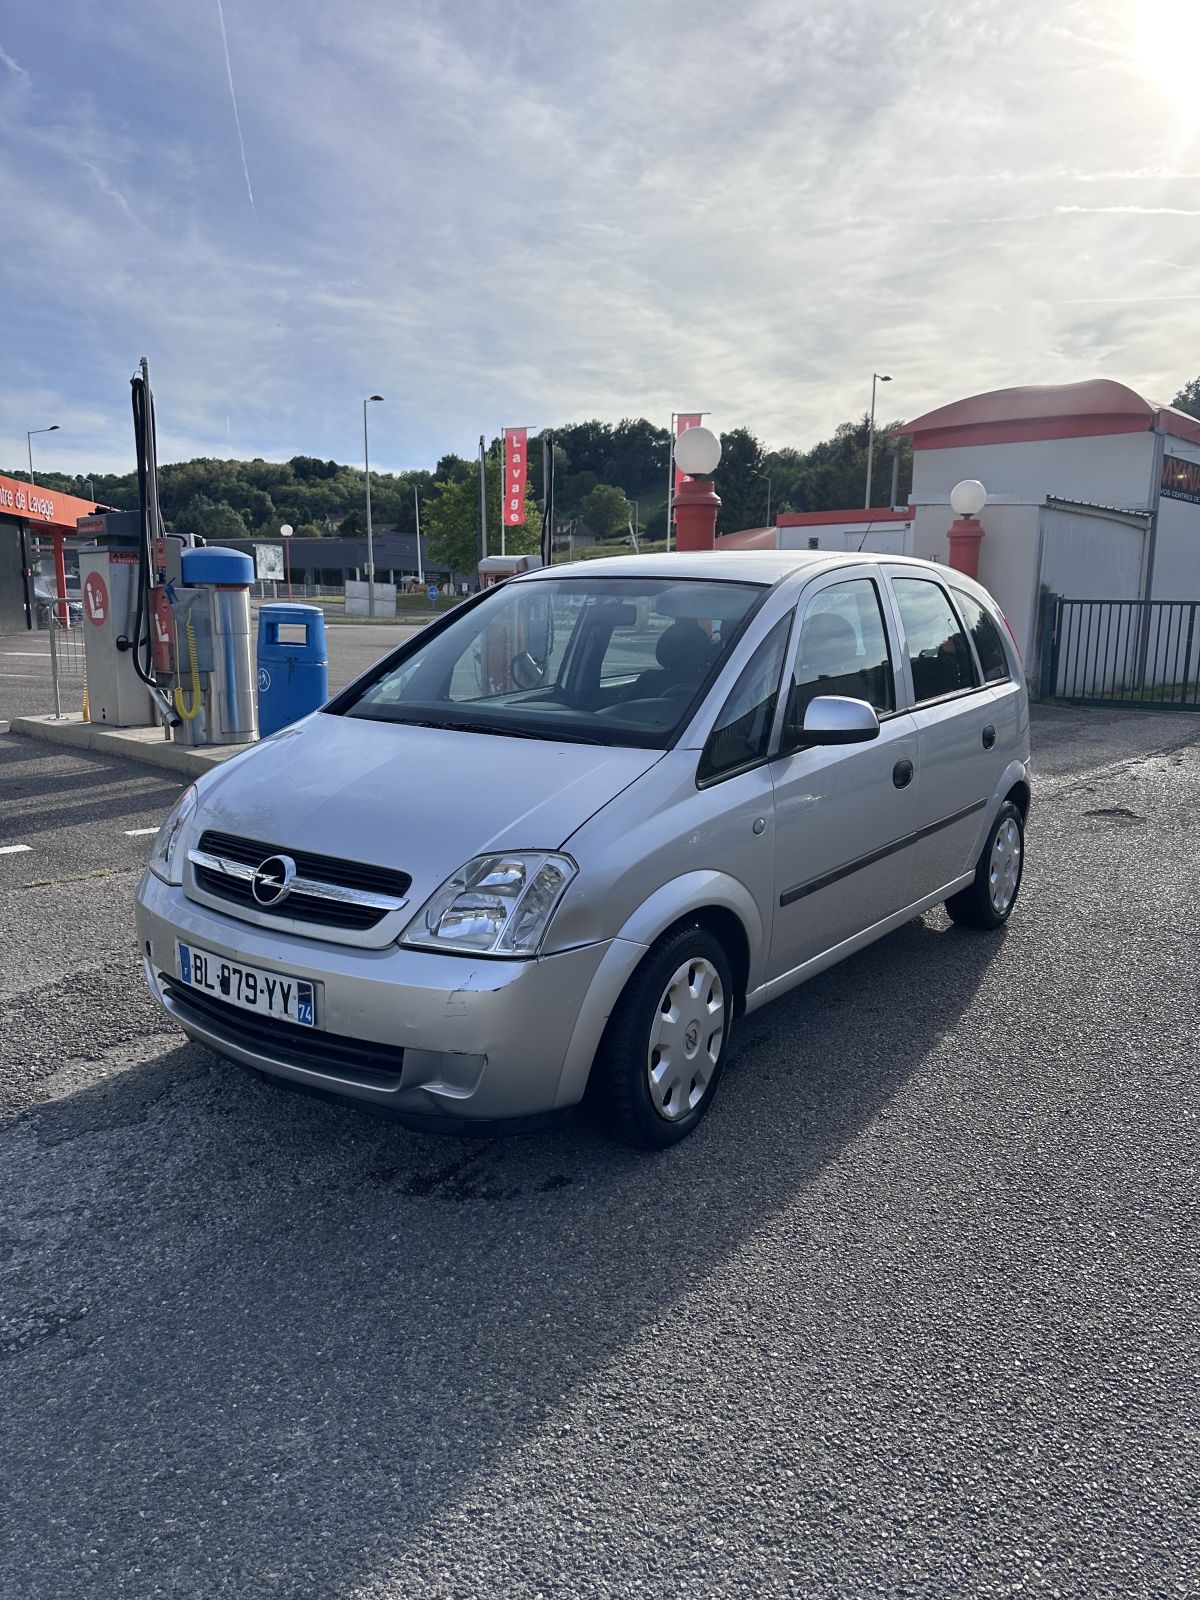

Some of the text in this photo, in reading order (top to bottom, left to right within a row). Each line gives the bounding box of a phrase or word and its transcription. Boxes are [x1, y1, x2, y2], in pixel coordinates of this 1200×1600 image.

[510, 435, 521, 522] Lavage
[15, 488, 26, 510] de
[27, 490, 54, 520] Lavage
[1171, 490, 1193, 501] CENTRES
[298, 1003, 311, 1022] 74
